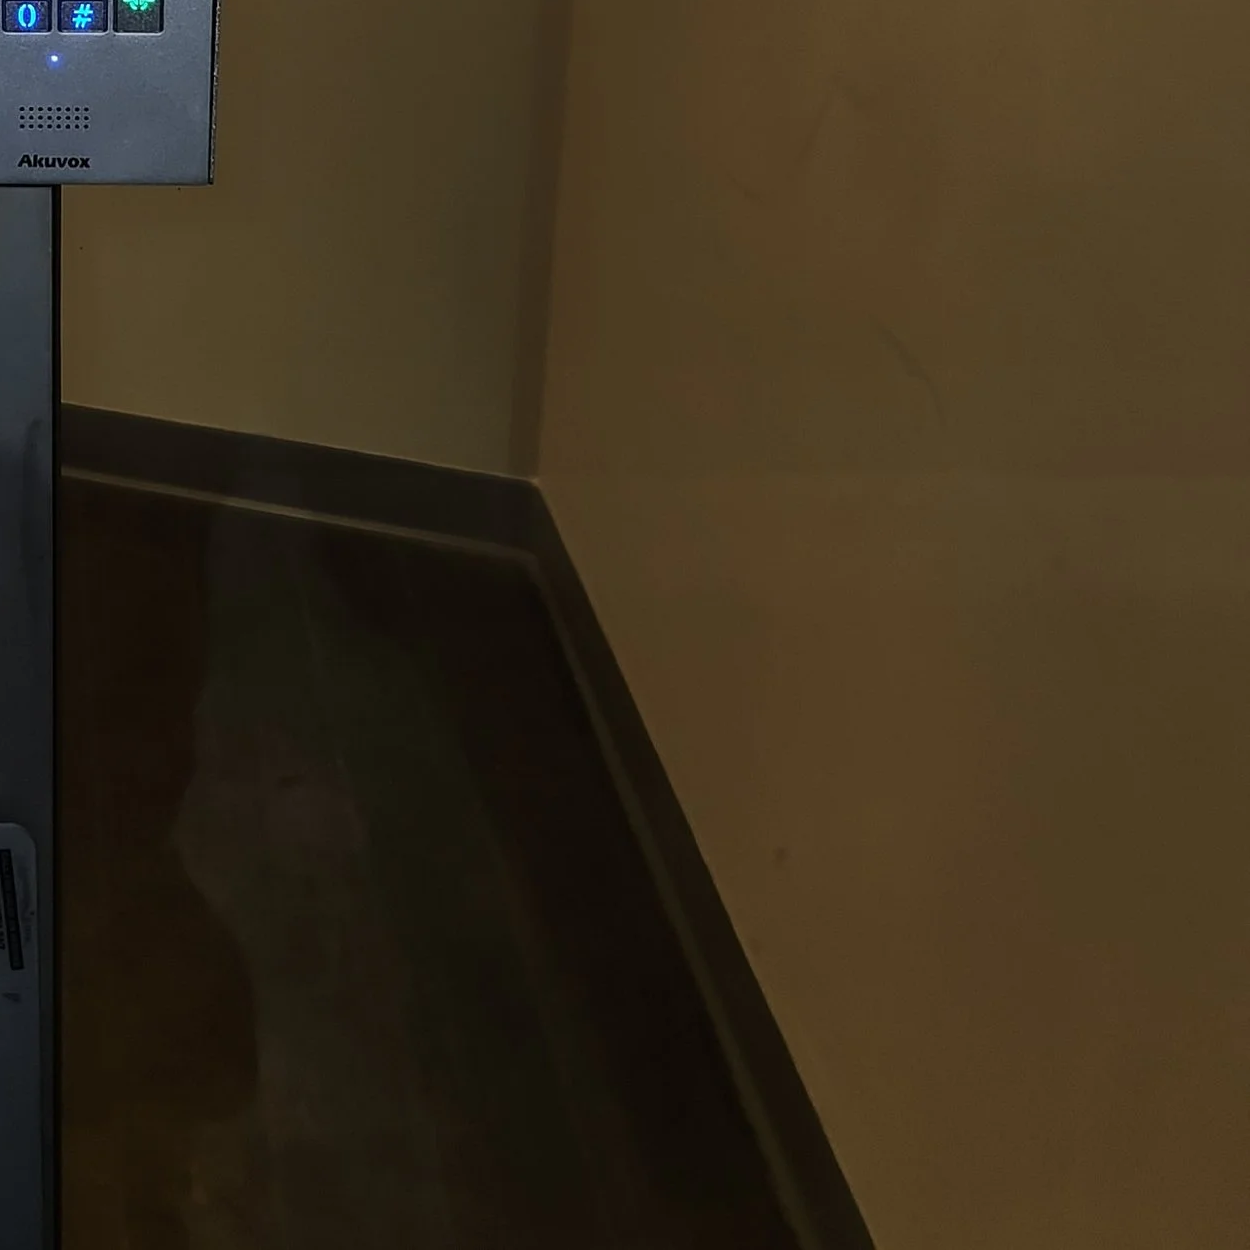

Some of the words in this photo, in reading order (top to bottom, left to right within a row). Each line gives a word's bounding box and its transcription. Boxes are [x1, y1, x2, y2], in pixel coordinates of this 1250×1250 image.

[17, 3, 38, 28] 0
[71, 3, 94, 29] #
[17, 154, 91, 169] Akuvox
